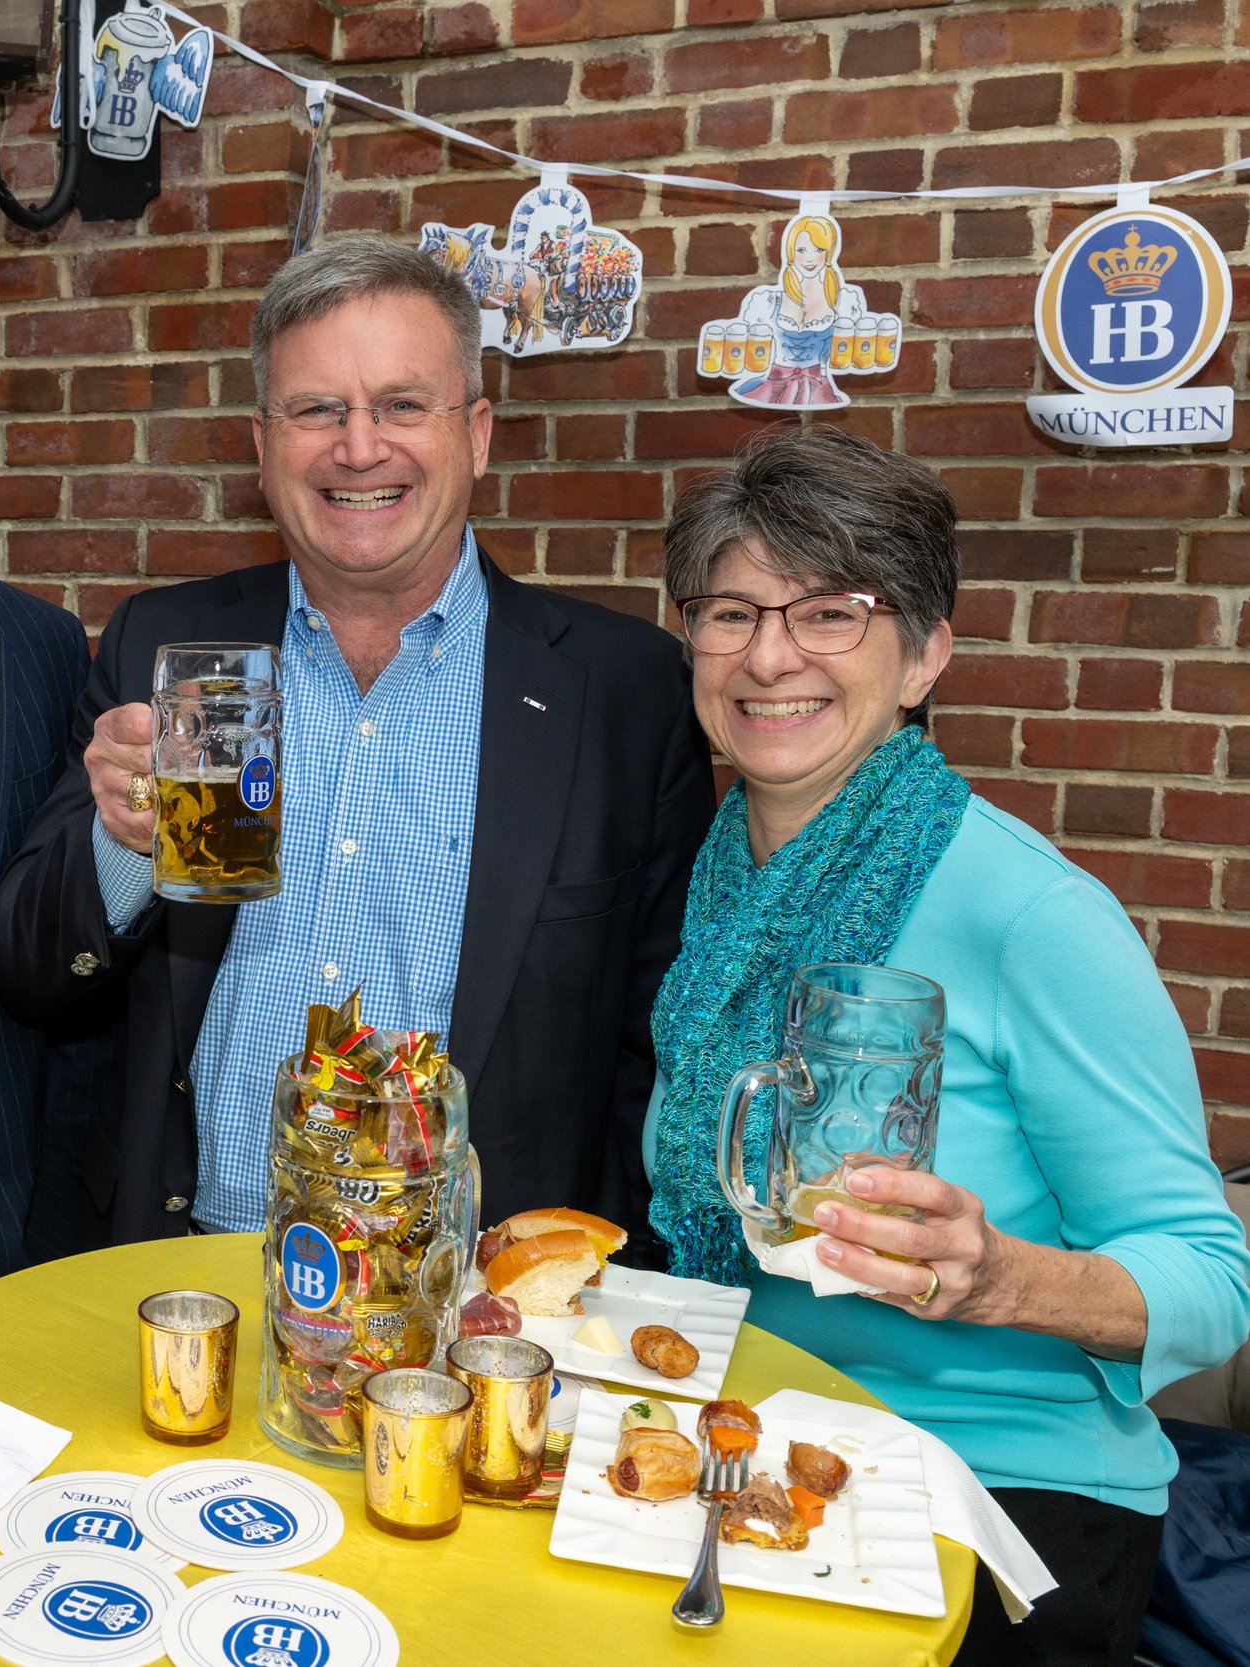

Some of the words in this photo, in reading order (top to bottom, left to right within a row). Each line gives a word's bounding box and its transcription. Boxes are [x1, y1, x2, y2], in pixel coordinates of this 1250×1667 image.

[108, 94, 137, 127] HB
[1089, 299, 1176, 365] HB
[1036, 404, 1227, 436] MÜNCHEN
[249, 781, 270, 803] HB
[291, 1261, 326, 1300] HB
[60, 1491, 131, 1511] NCHEN
[168, 1475, 253, 1505] MÜNCHEN
[73, 1515, 122, 1540] HB
[214, 1501, 266, 1526] HB
[2, 1562, 62, 1620] MÜNCHEN
[57, 1589, 108, 1622] HB
[233, 1594, 341, 1620] MÜNCHEN
[252, 1623, 305, 1652] HB
